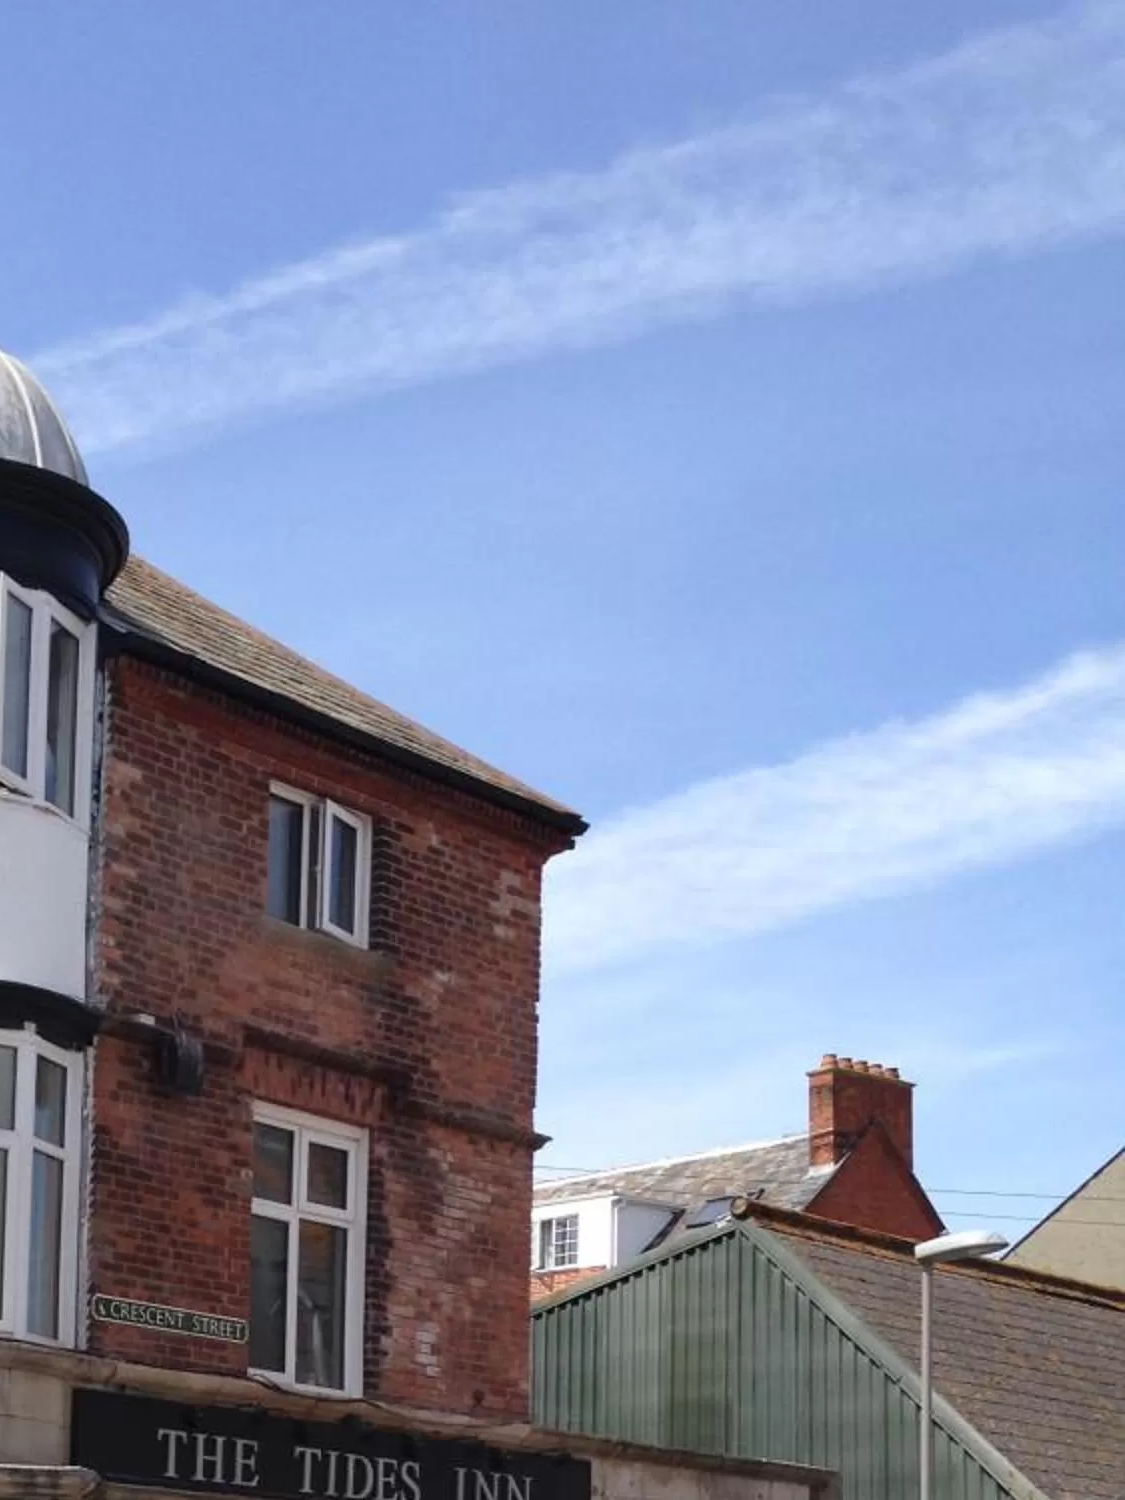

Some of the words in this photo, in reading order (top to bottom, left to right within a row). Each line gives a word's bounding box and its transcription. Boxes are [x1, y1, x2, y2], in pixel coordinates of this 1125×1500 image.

[110, 1301, 184, 1328] CRESCENT
[192, 1315, 242, 1338] STREET
[157, 1428, 260, 1488] THE
